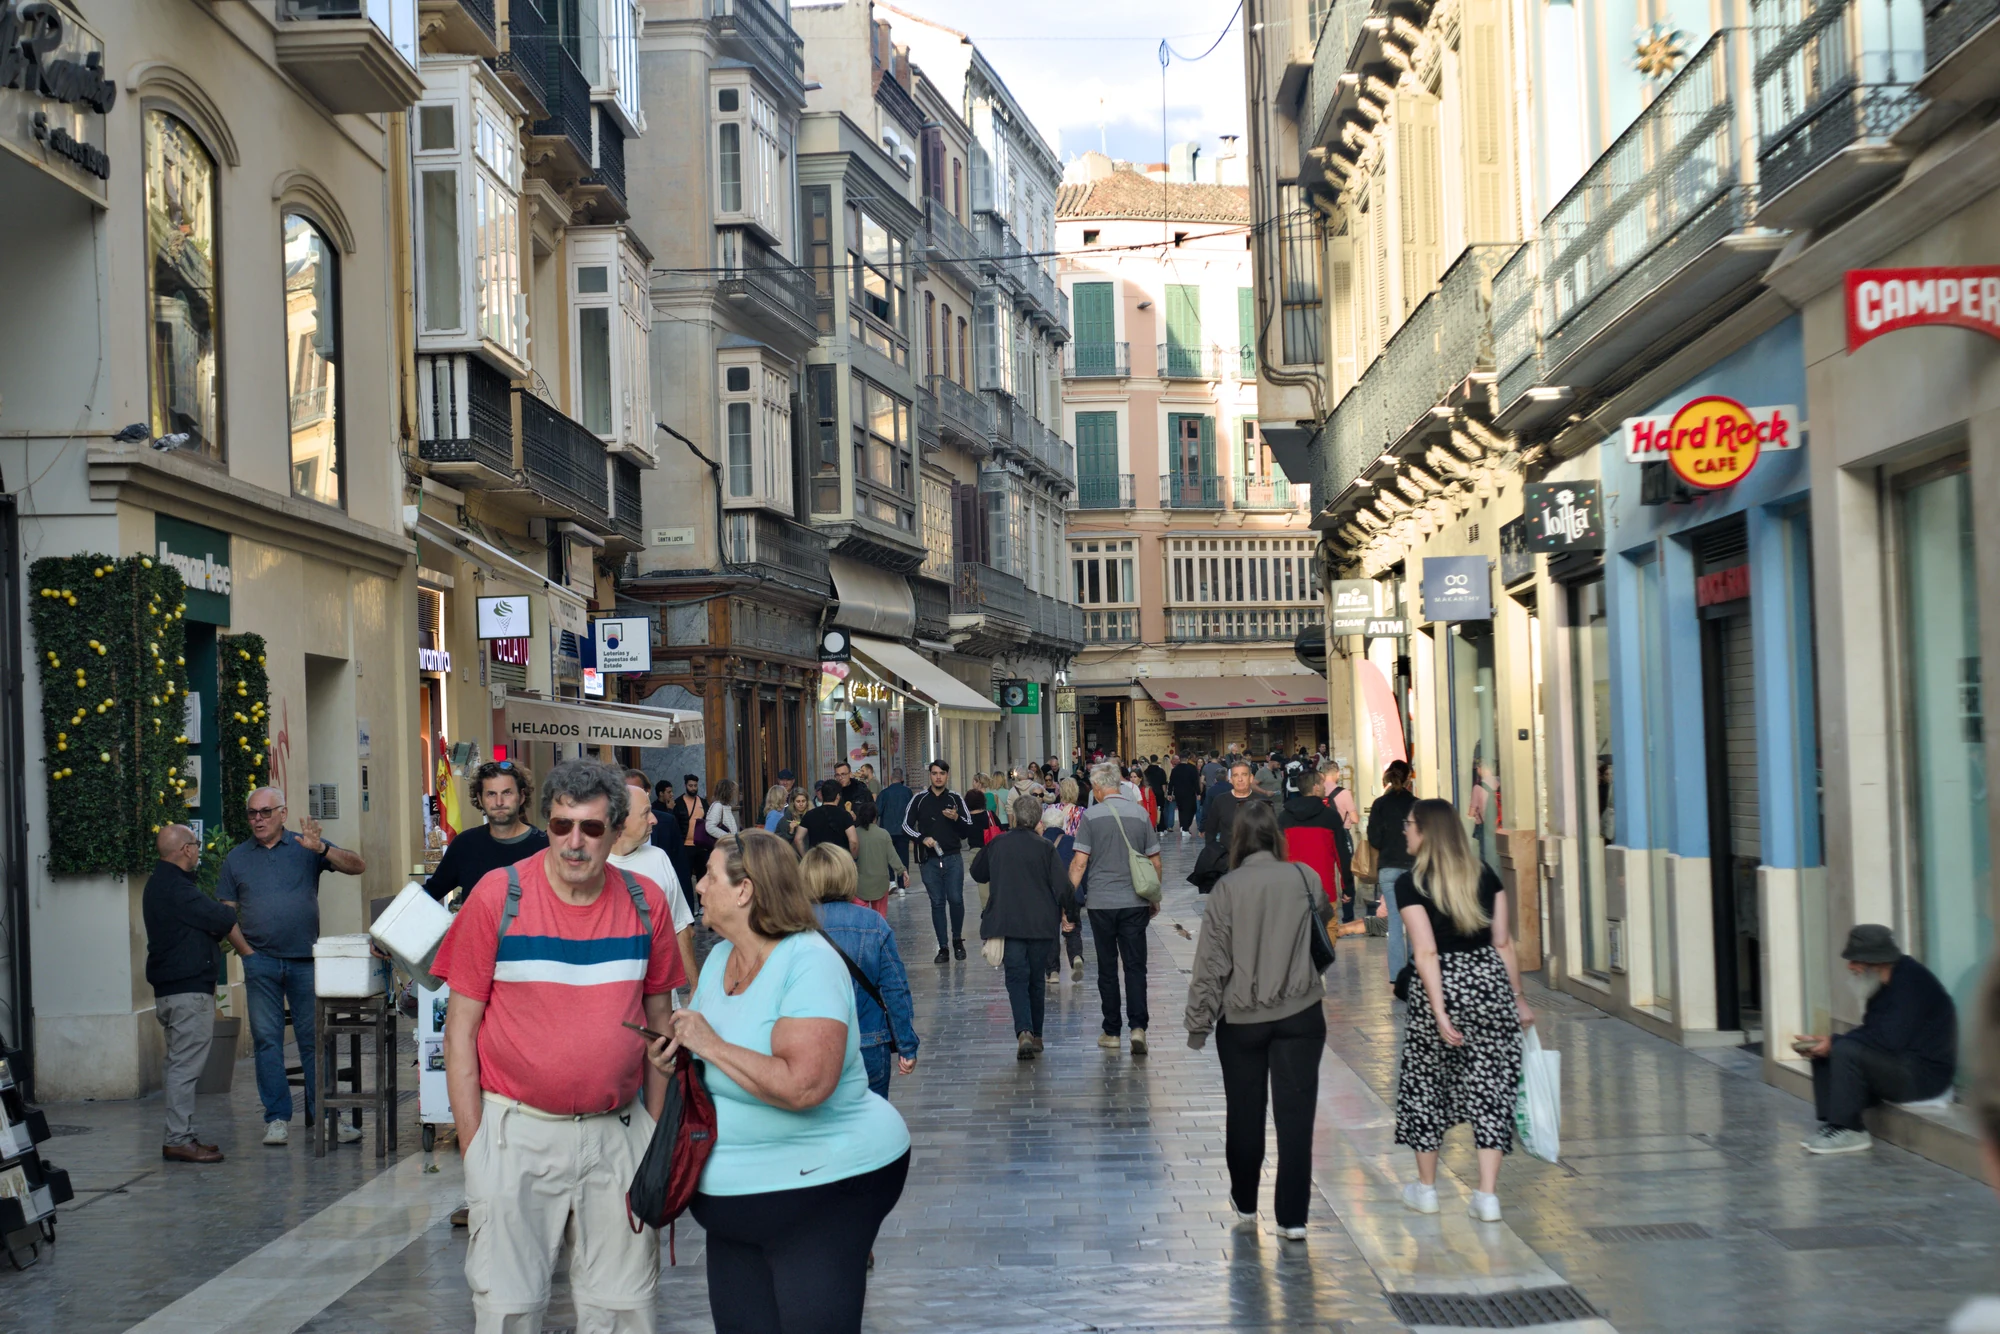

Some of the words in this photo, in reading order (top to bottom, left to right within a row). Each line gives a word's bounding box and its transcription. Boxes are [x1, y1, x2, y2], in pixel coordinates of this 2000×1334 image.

[1857, 277, 2000, 330] CAMPER
[1632, 416, 1710, 453] Hard
[1714, 410, 1789, 452] Rock
[1693, 456, 1737, 473] CAFE
[1338, 588, 1368, 606] Ria
[1367, 621, 1404, 634] ATM
[418, 648, 451, 672] iramira
[512, 722, 580, 736] HELADOS
[588, 726, 663, 741] ITALIANOS
